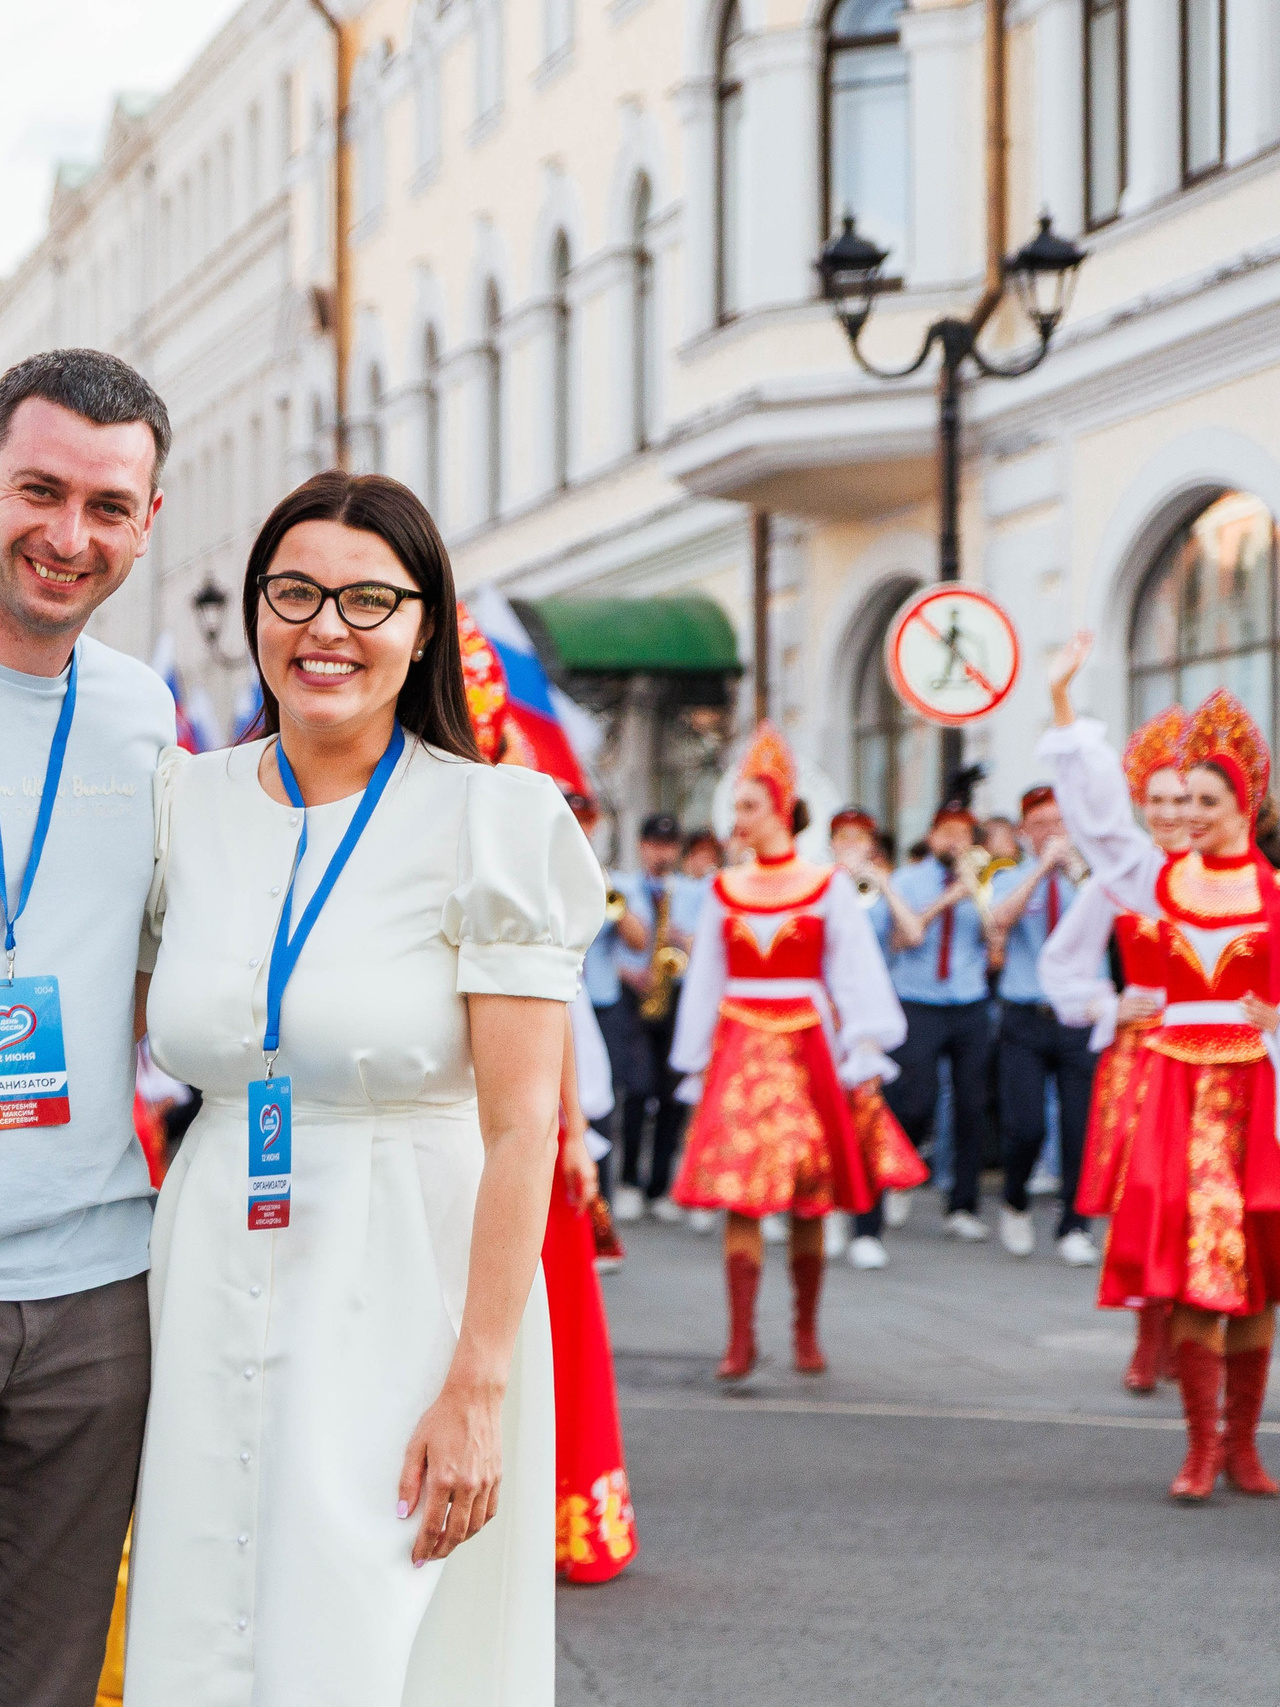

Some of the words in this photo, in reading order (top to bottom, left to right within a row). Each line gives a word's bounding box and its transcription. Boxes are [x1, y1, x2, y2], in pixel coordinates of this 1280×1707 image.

[34, 986, 54, 995] 1004
[0, 1018, 18, 1026] ДЕНЬ
[5, 1052, 36, 1062] ИЮНЯ
[2, 1110, 34, 1118] МАКСИМ
[0, 1116, 38, 1125] СЕРГЕЕВИЧ
[253, 1180, 287, 1191] ОРГАНИЗАТОР
